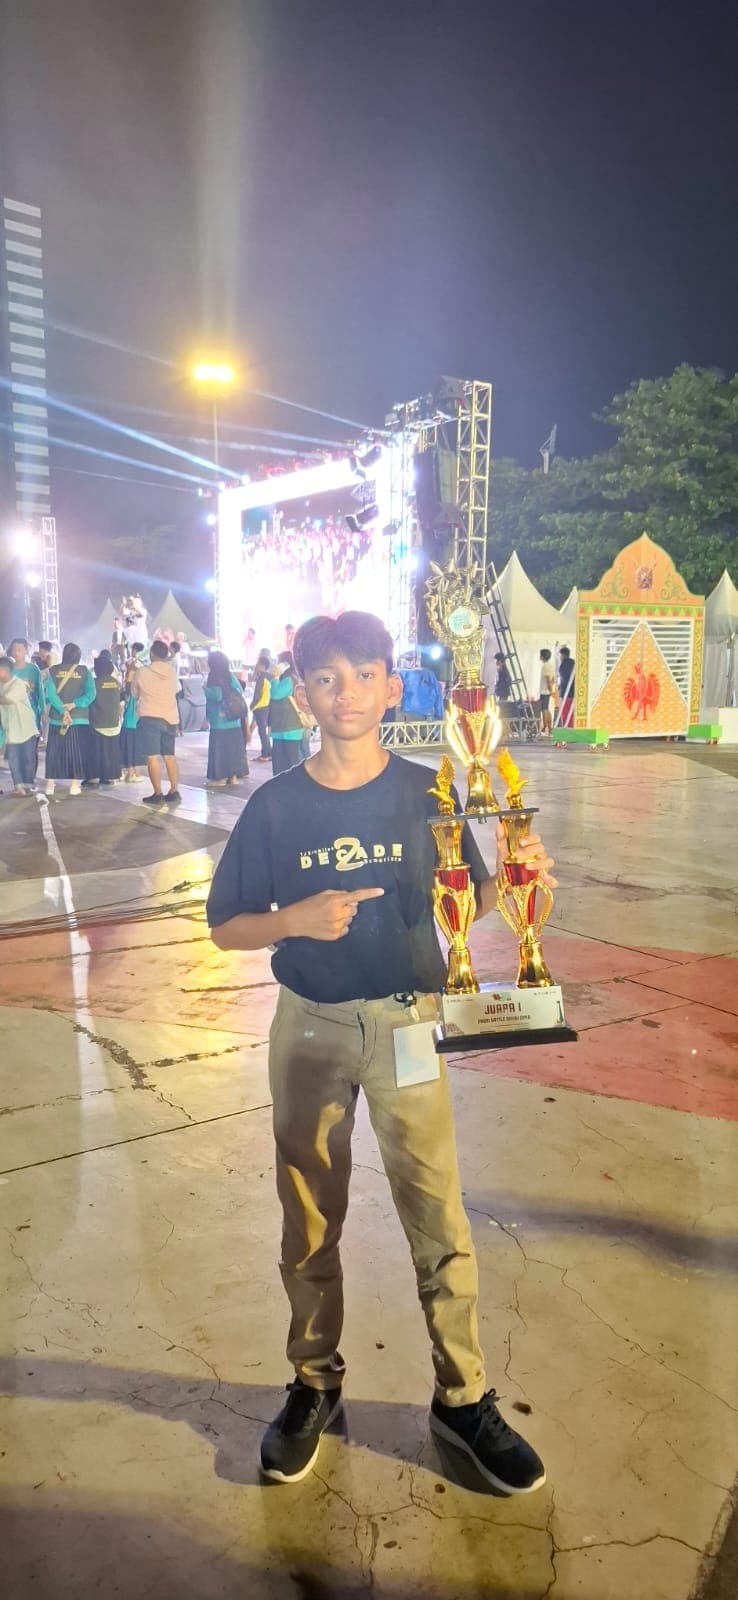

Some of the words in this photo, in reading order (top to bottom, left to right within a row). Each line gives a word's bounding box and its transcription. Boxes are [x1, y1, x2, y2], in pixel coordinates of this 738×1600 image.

[300, 843, 402, 869] DECADE
[333, 837, 364, 871] 2
[485, 1003, 516, 1014] JUARA
